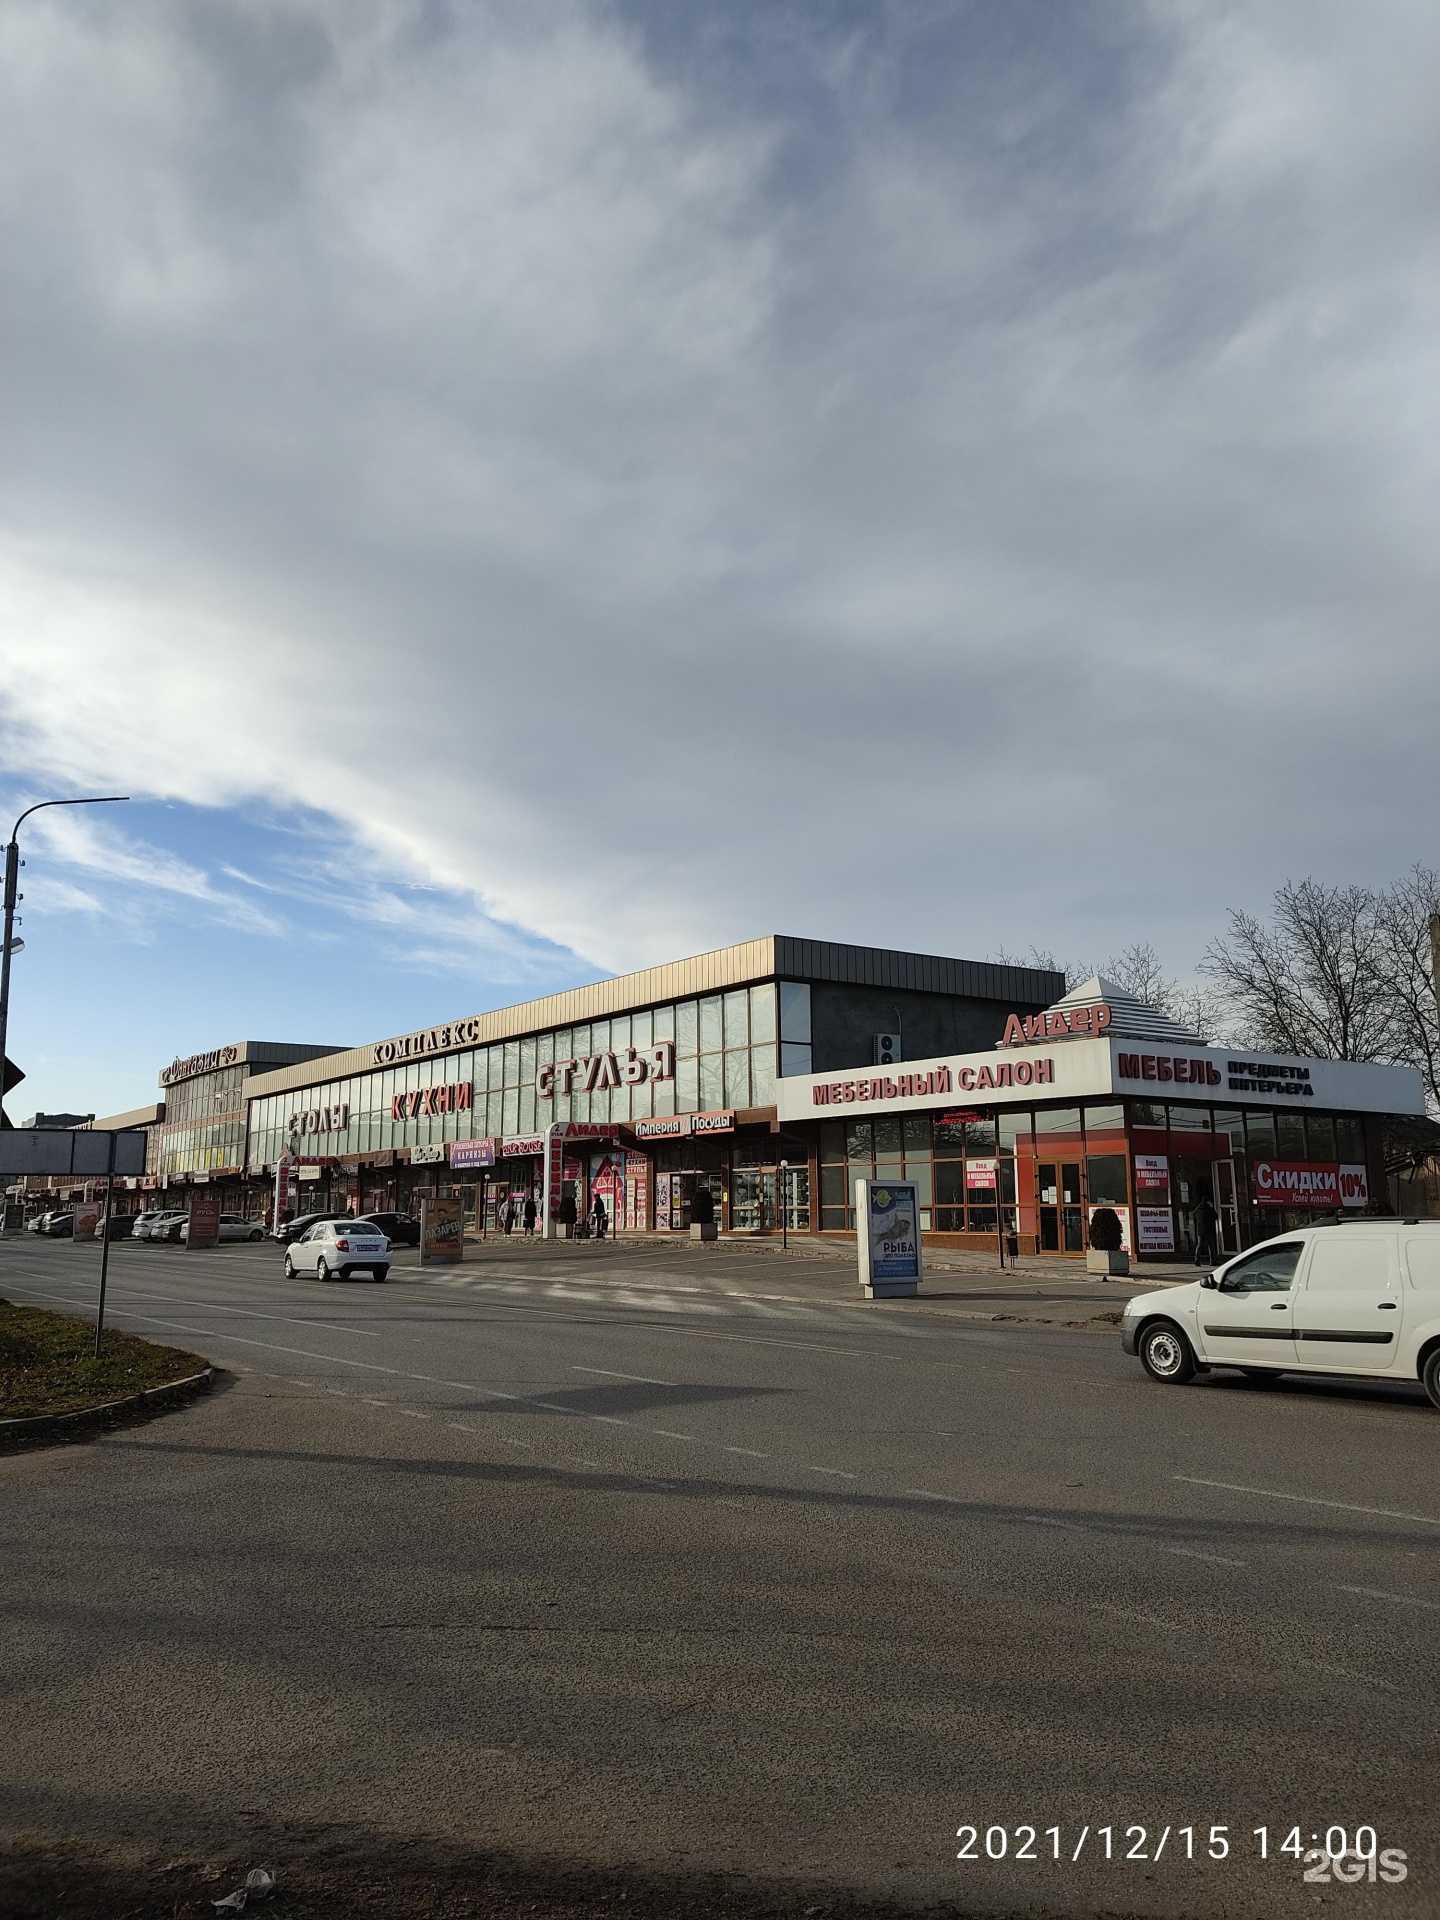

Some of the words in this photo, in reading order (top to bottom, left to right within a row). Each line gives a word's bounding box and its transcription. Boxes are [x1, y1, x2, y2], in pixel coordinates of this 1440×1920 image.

[1001, 1004, 1112, 1044] Лидер
[372, 1020, 479, 1065] КОМПЛЕКС
[535, 1040, 675, 1099] СТУЛЬЯ
[812, 1065, 953, 1105] МЕБЕЛЬНЫЙ
[958, 1059, 1055, 1091] САЛОН
[1118, 1053, 1222, 1085] МЕБЕЛЬ
[1227, 1061, 1310, 1080] ПРЕДМЕТЫ
[391, 1081, 474, 1122] КУХНИ
[1228, 1077, 1314, 1096] ИНТЕРЬЕРА
[288, 1104, 349, 1137] СТОЛЫ
[635, 1119, 680, 1137] Империя
[692, 1115, 732, 1131] Посуды
[1257, 1163, 1337, 1194] Скидки
[1340, 1173, 1367, 1198] 10%
[883, 1242, 916, 1253] РЫБА
